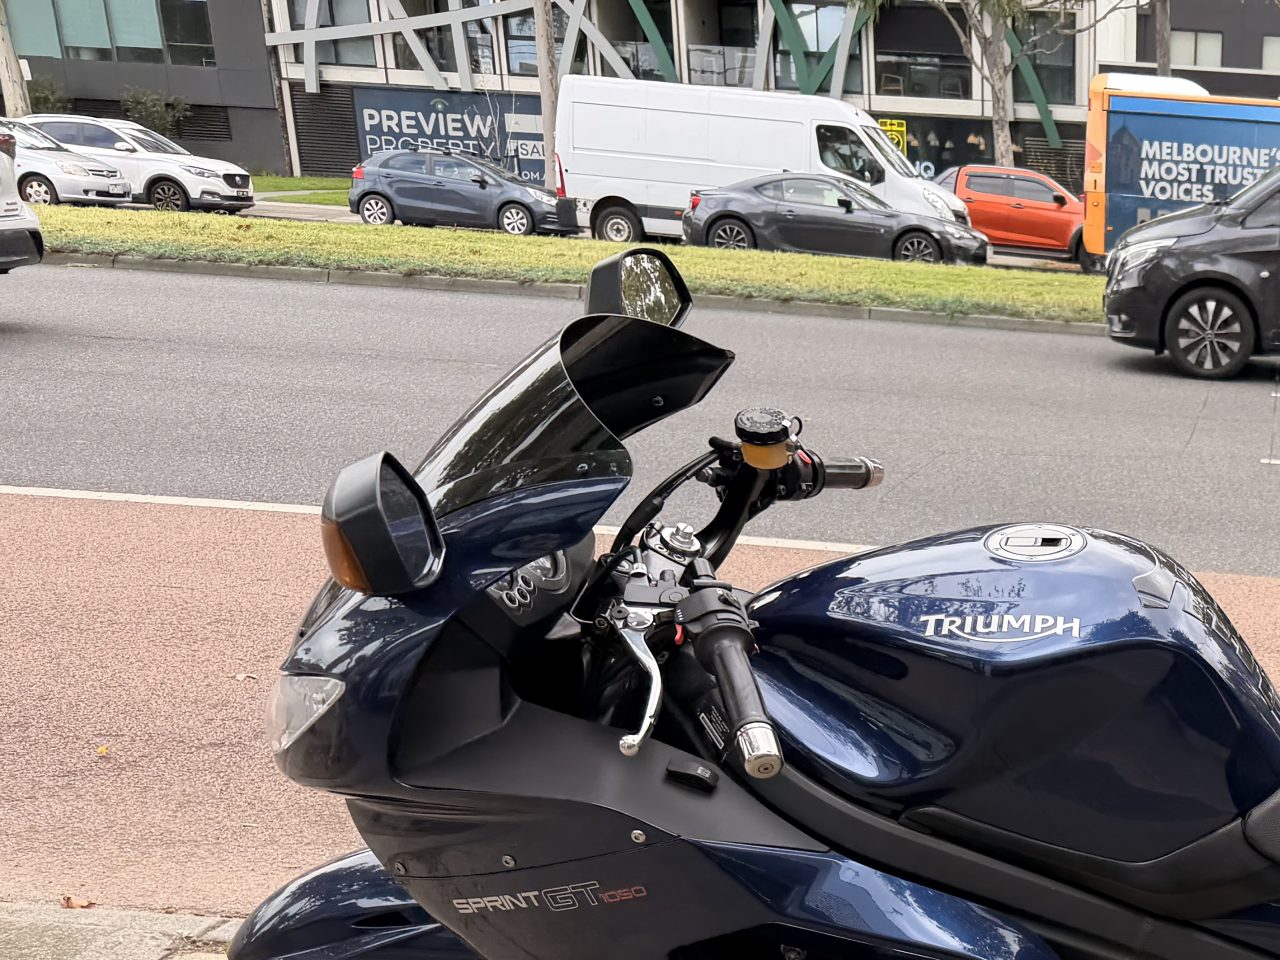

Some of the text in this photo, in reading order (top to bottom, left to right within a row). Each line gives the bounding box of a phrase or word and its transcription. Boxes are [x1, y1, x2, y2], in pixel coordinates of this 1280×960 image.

[362, 108, 493, 138] PREVIEW
[1140, 161, 1271, 186] MOST TRUST
[1139, 180, 1214, 203] VOICES
[920, 613, 1081, 642] TRIUMPH
[452, 880, 648, 914] SPRINT GT 1050
